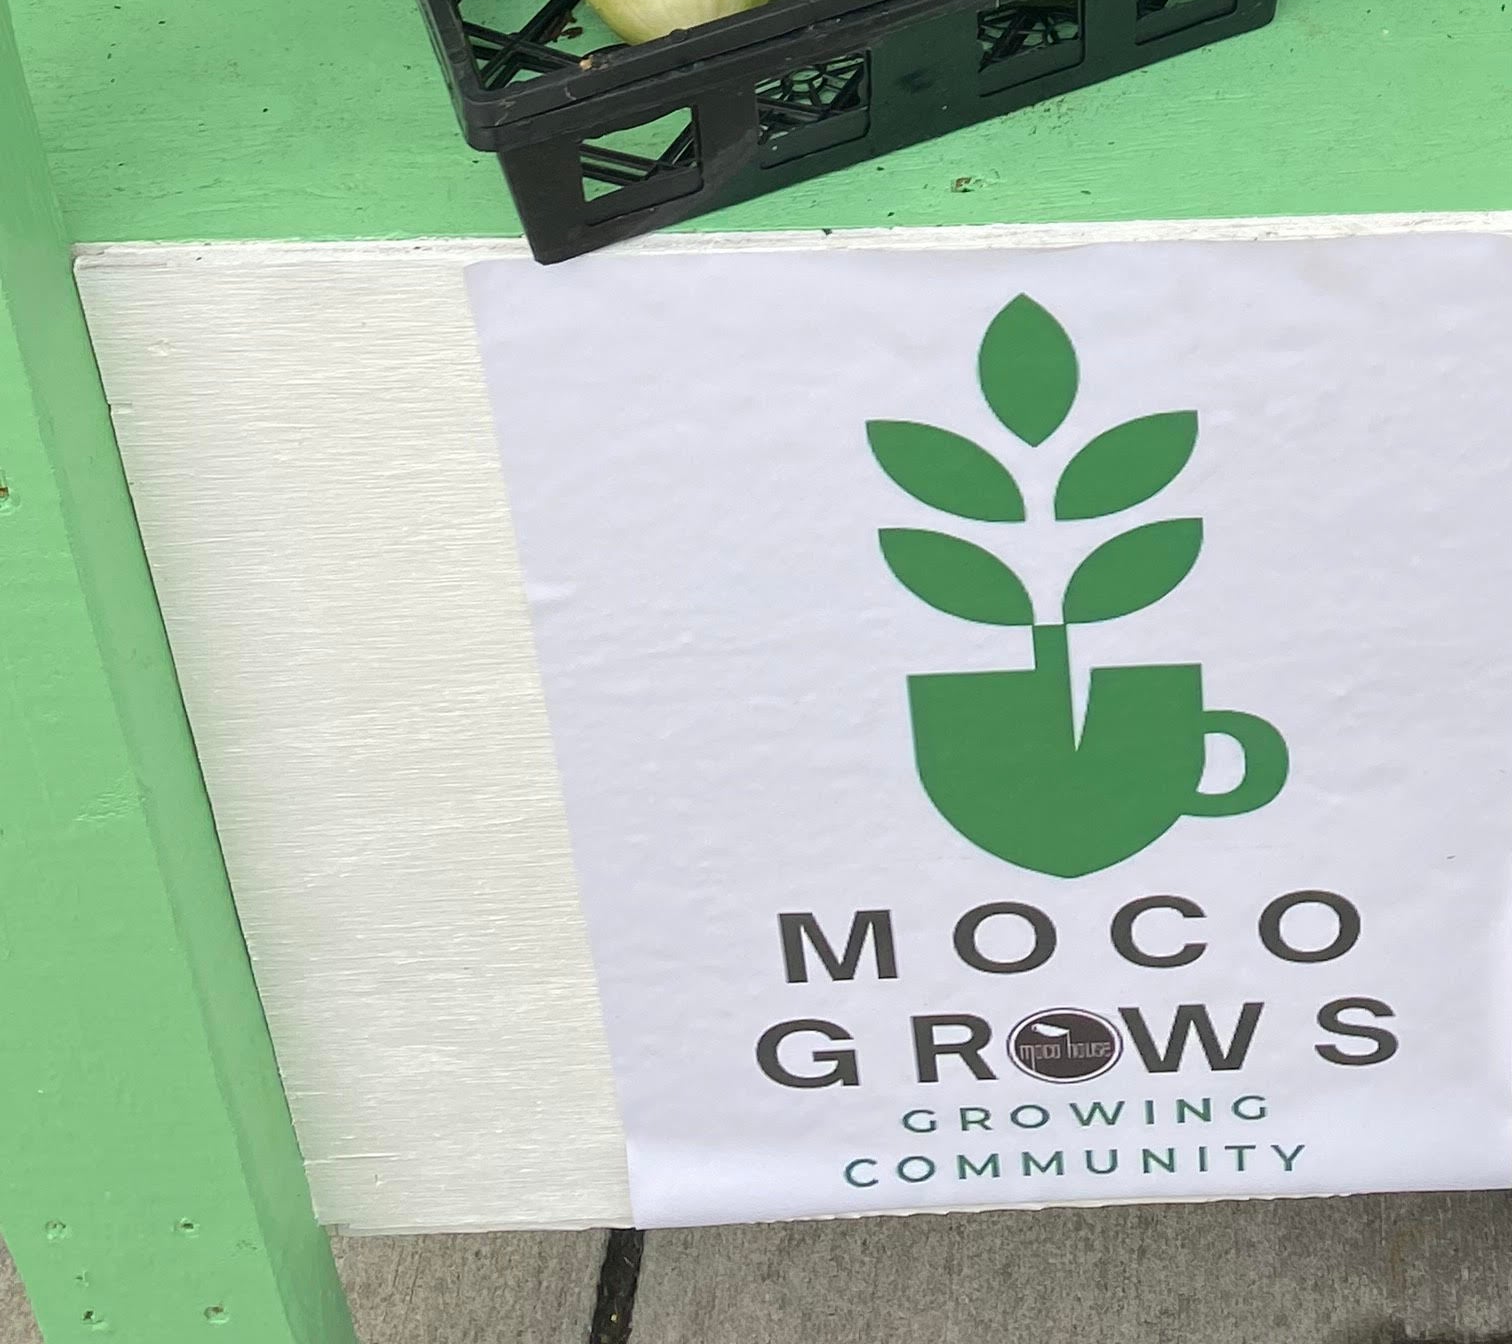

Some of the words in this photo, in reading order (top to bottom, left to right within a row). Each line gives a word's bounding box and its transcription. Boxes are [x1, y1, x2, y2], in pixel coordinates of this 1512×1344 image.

[778, 890, 1361, 983] MOCO
[755, 997, 1399, 1089] GROWS
[901, 1095, 1269, 1133] GROWING
[844, 1144, 1307, 1188] COMMUNITY
